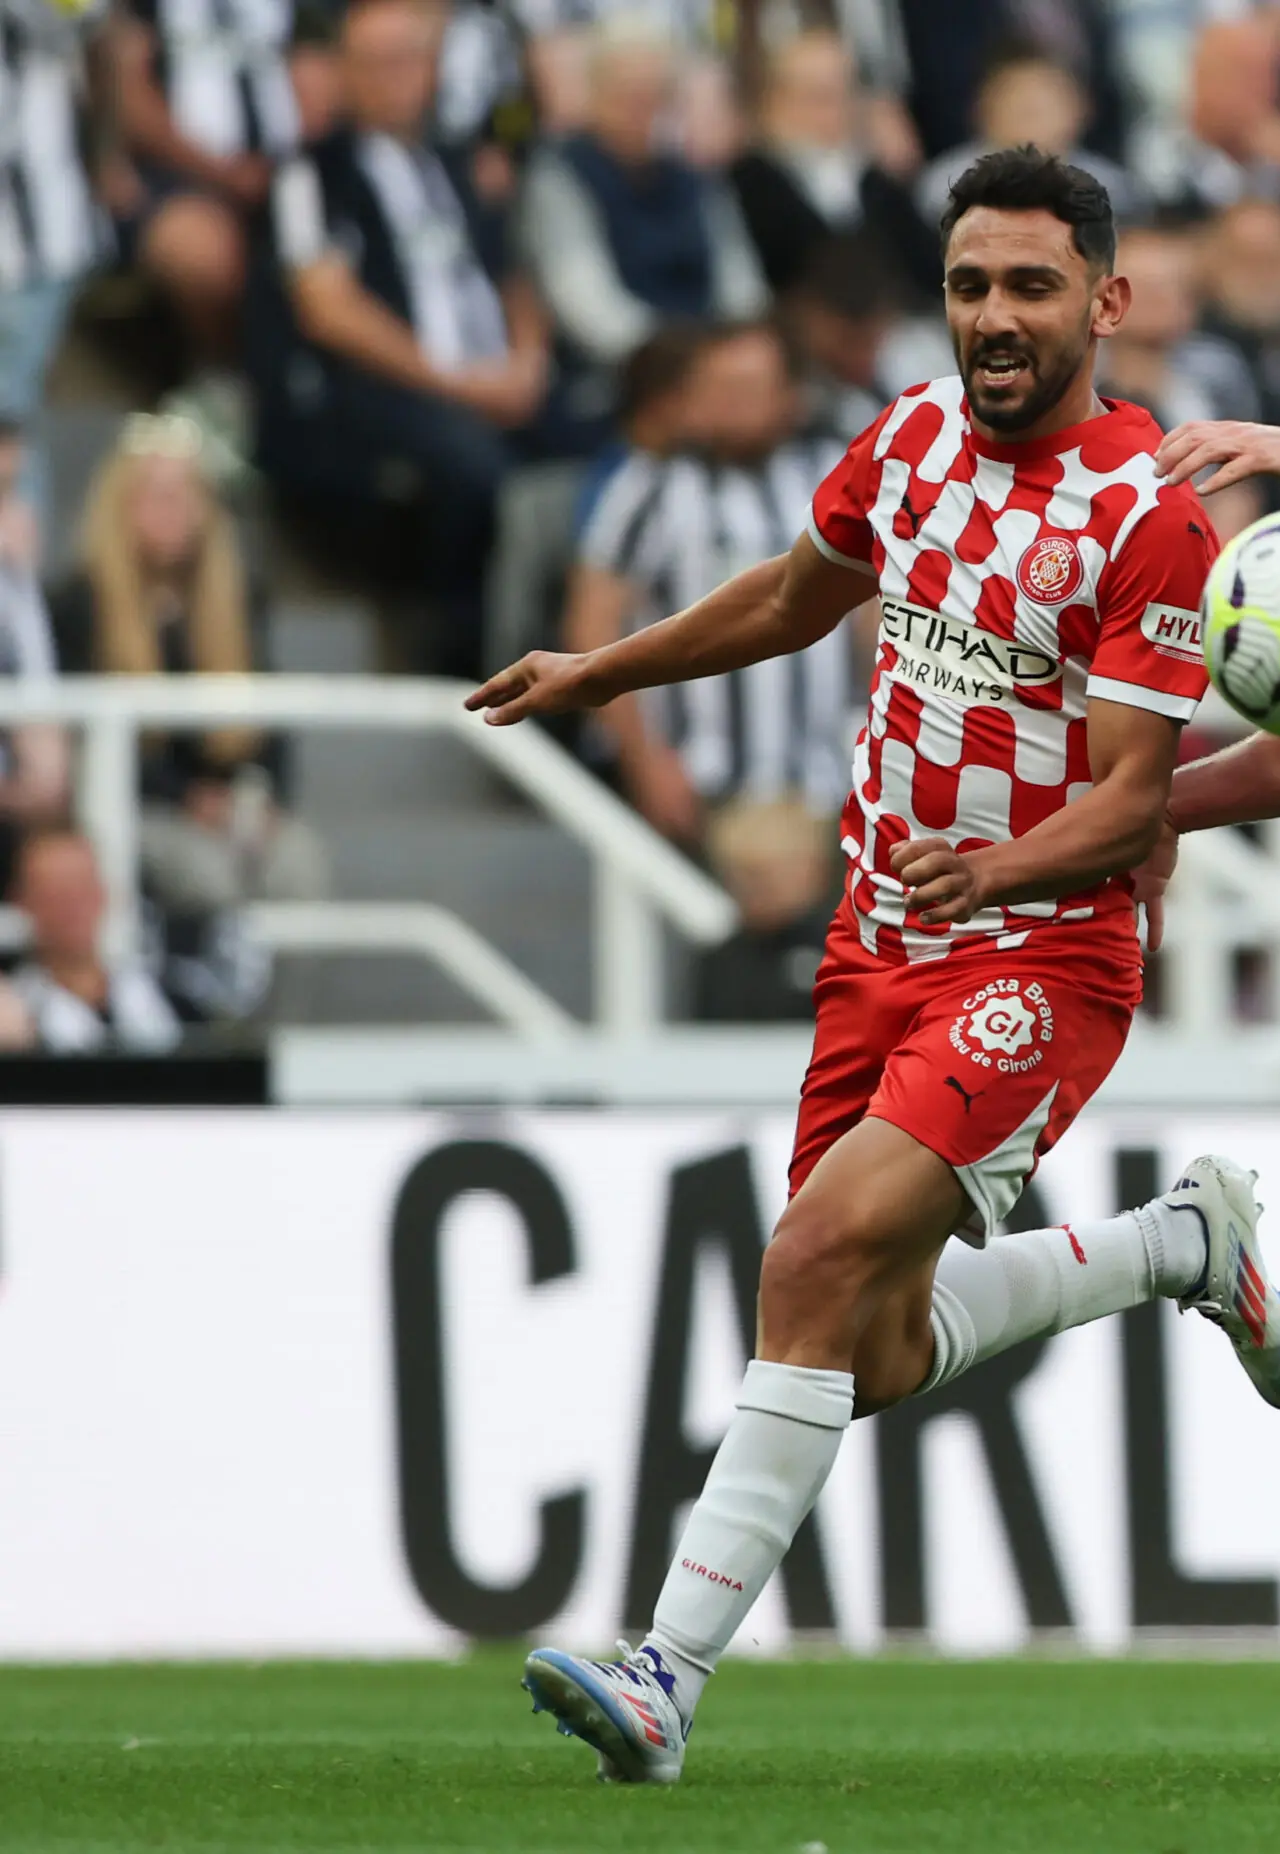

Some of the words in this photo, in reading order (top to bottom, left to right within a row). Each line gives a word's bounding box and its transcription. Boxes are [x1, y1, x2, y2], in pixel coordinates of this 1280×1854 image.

[1039, 540, 1075, 562] GIRONA
[1045, 590, 1063, 599] CLUB
[882, 601, 1057, 680] ETIHAD
[897, 656, 1004, 702] AIRWAYS
[962, 978, 1020, 1010] Costa
[1023, 981, 1055, 1042] Brava
[971, 1051, 992, 1067] de
[997, 1049, 1043, 1073] Girona
[682, 1558, 744, 1592] GIRONA
